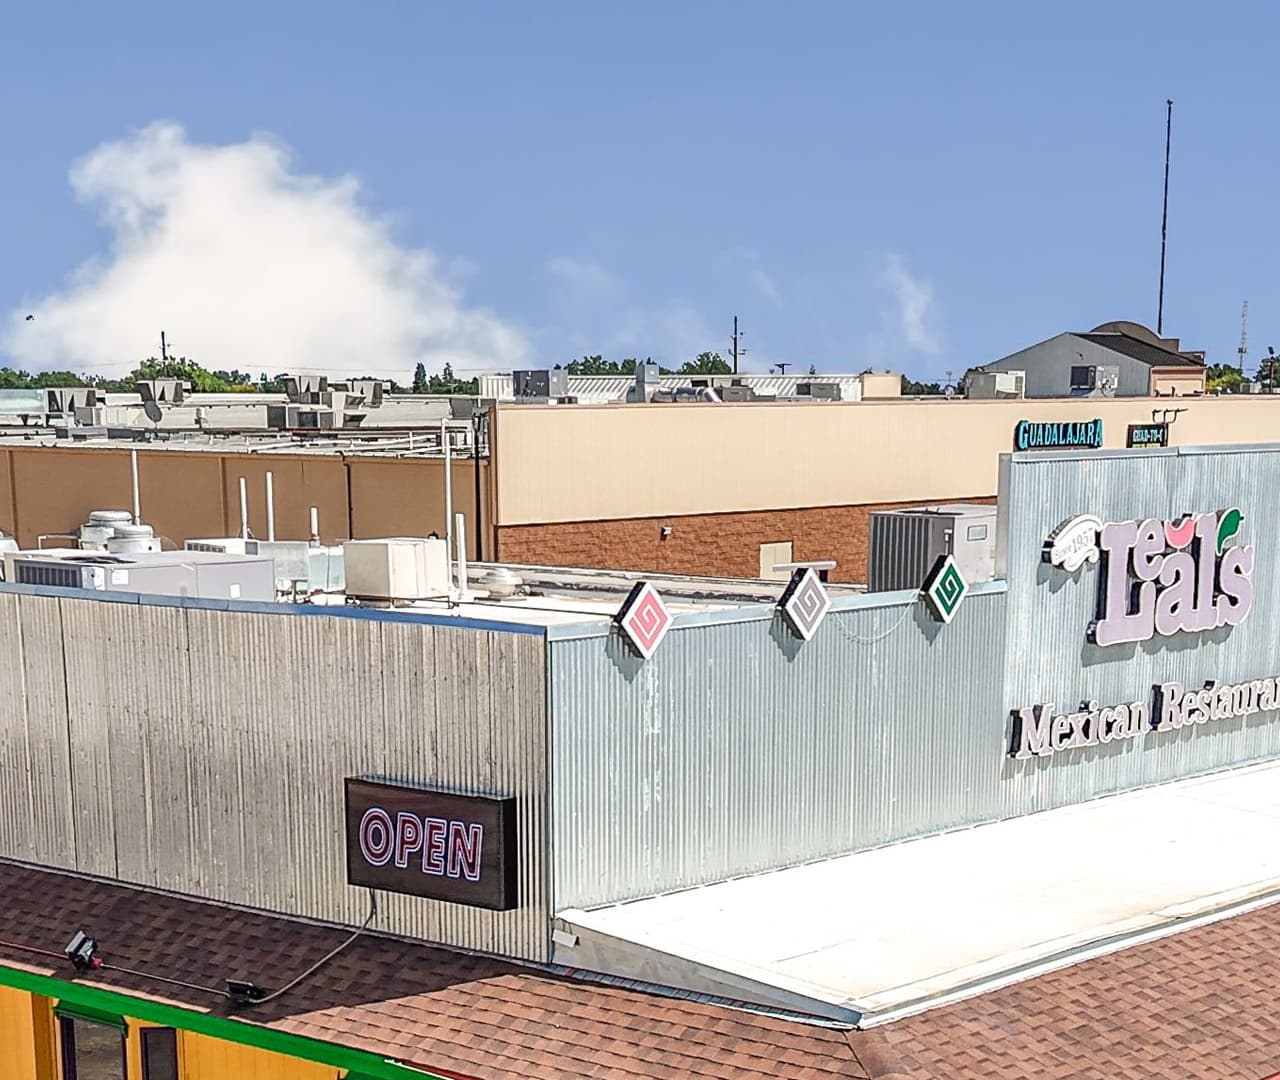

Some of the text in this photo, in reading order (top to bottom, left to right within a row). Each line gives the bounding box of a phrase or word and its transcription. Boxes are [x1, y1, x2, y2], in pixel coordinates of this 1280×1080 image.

[1019, 419, 1103, 449] GUADALAJARA
[1015, 700, 1152, 760] Mexican
[359, 807, 483, 881] OPEN
